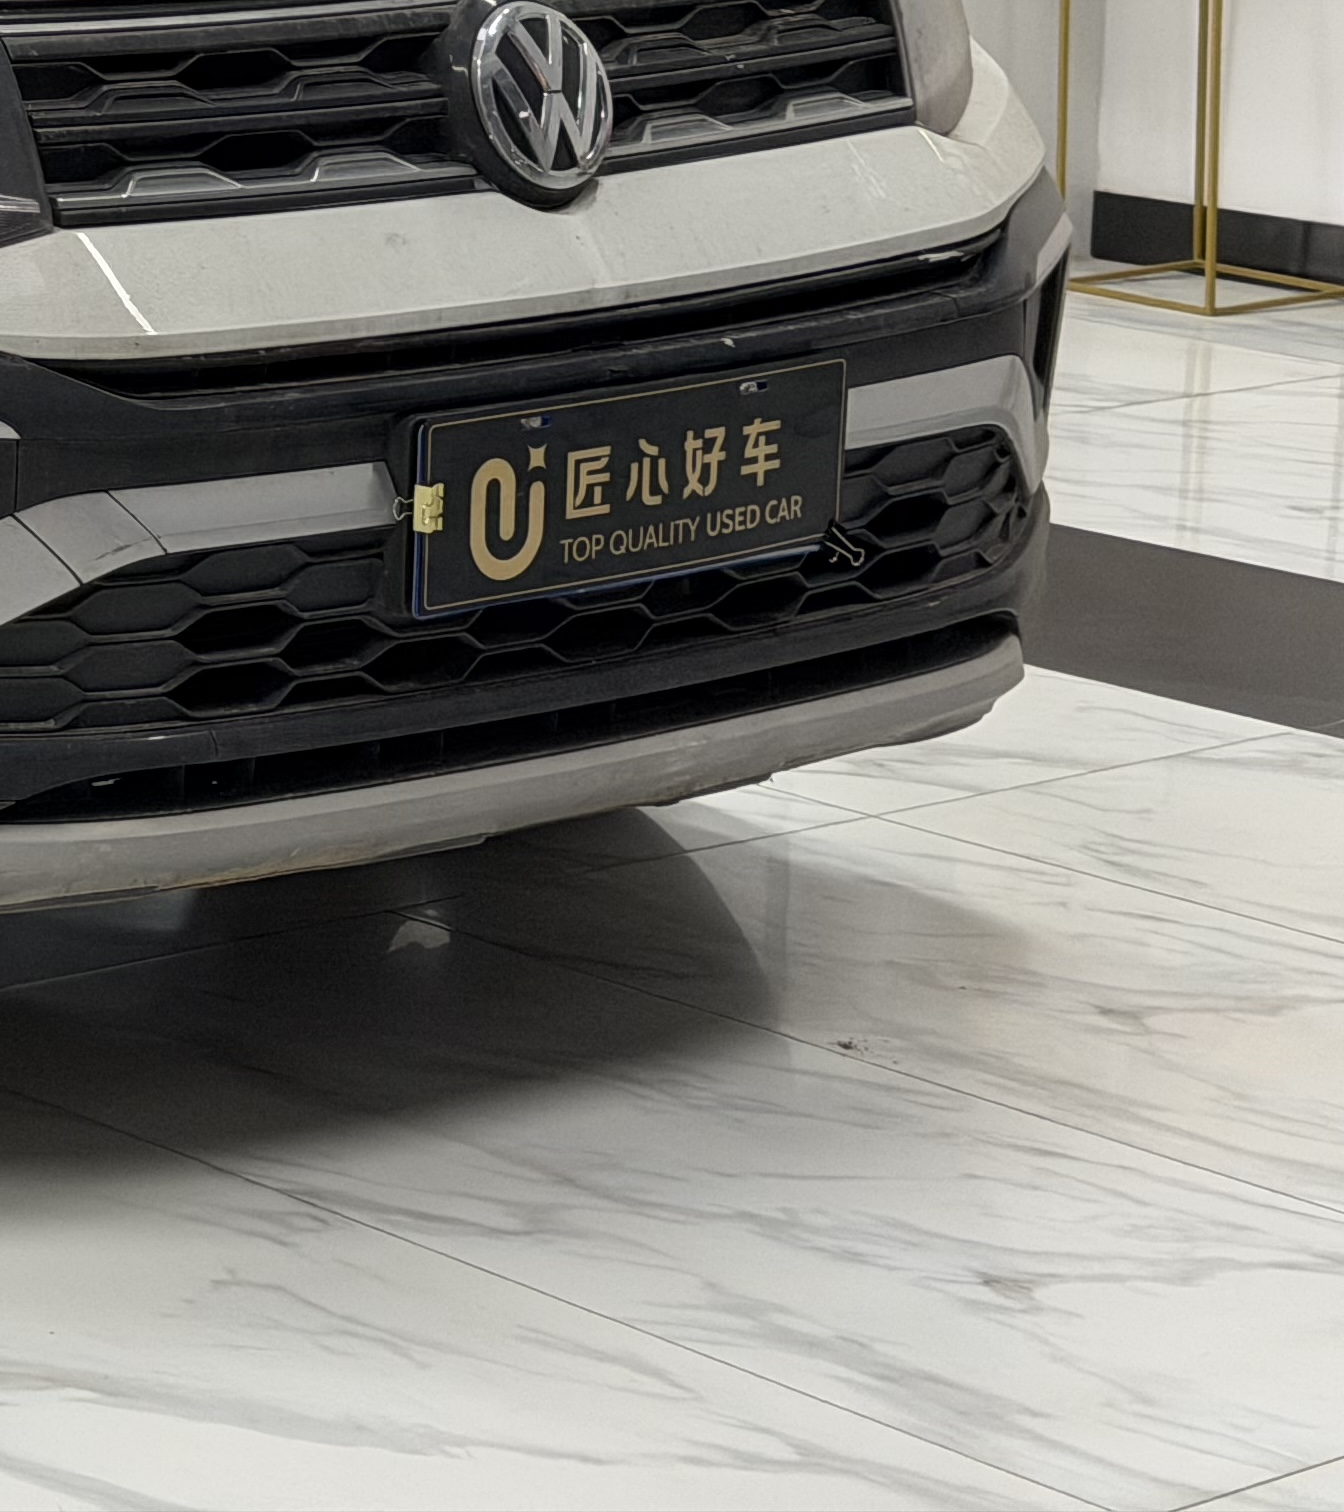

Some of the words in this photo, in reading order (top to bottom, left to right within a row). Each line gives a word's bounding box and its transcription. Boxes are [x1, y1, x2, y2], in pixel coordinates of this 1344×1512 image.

[565, 417, 782, 520] 匠心好车
[559, 536, 604, 564] TOP
[609, 516, 702, 556] QUALITY
[706, 504, 761, 537] USED
[764, 494, 803, 525] CAR
